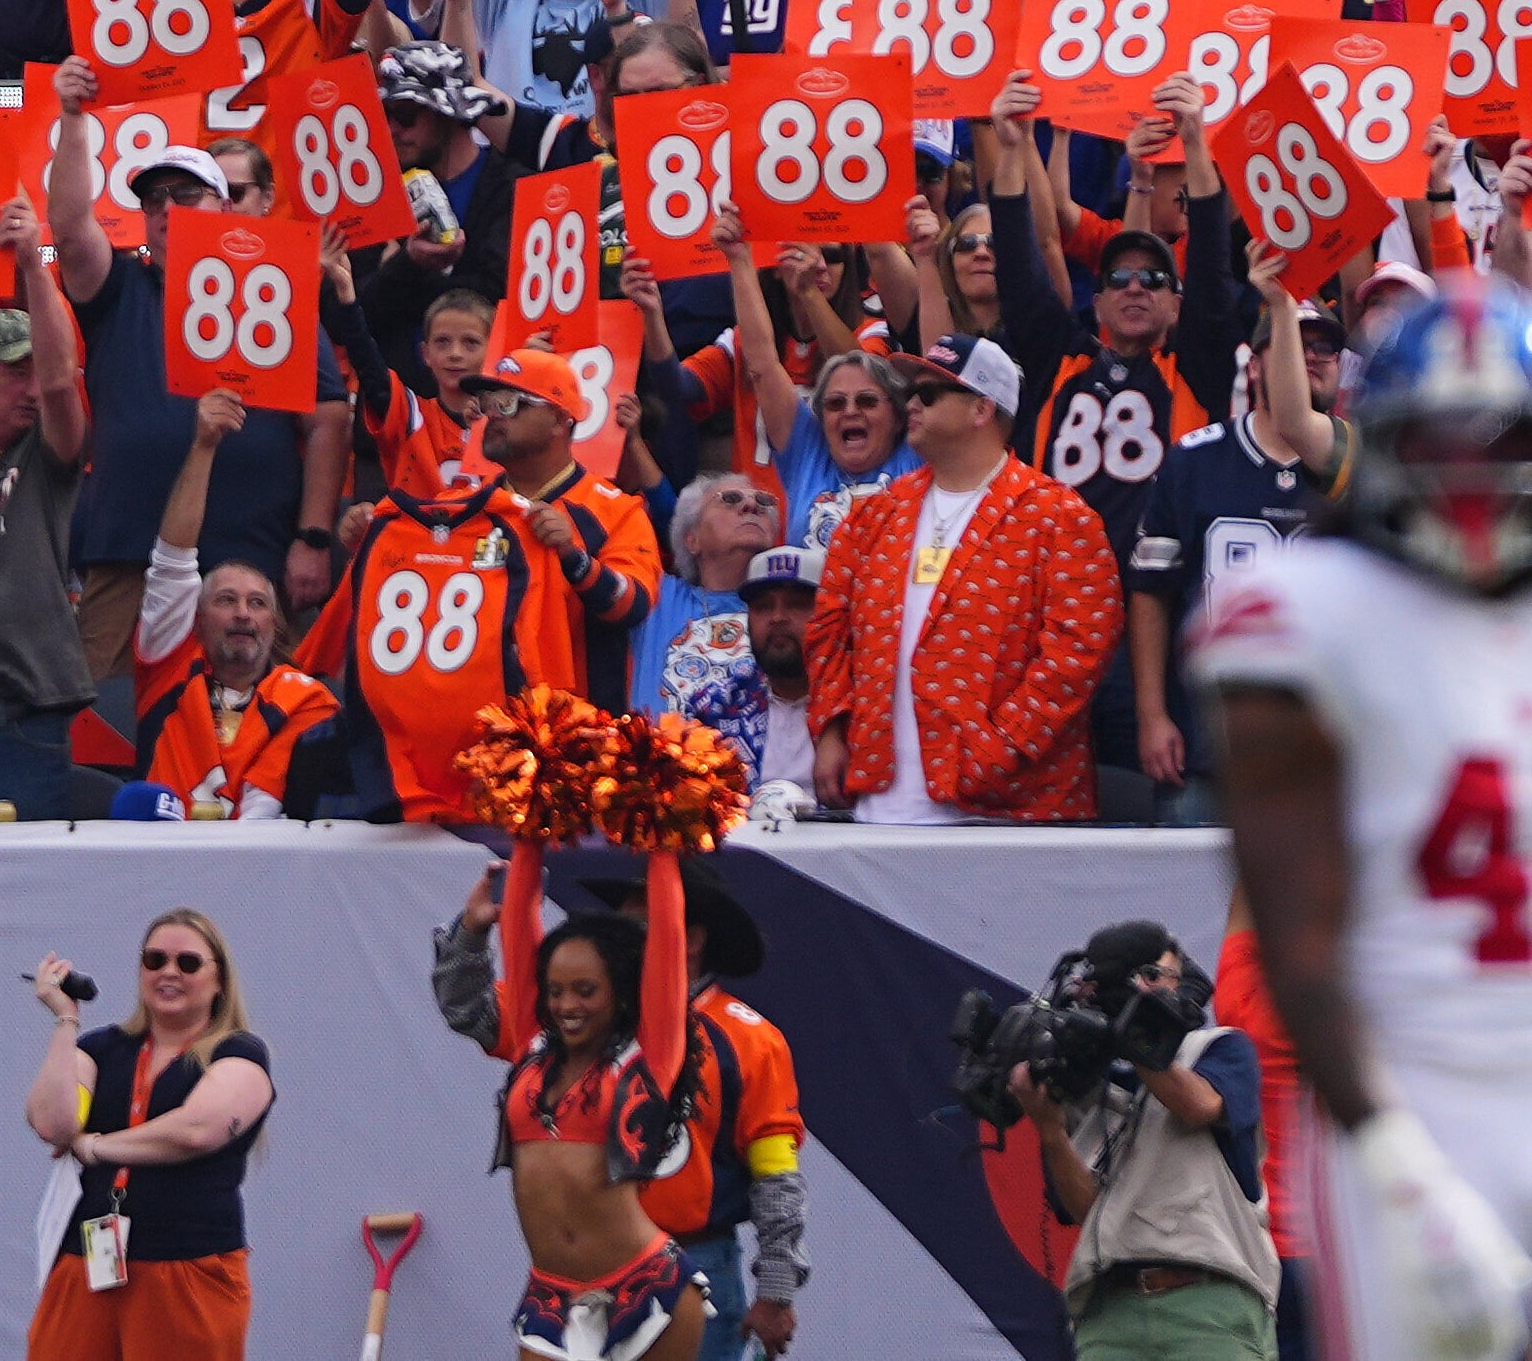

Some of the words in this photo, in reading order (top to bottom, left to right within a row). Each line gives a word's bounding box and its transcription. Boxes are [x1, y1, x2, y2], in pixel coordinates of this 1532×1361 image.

[1051, 389, 1164, 485] 88
[767, 555, 799, 577] ny
[370, 570, 484, 674] 88
